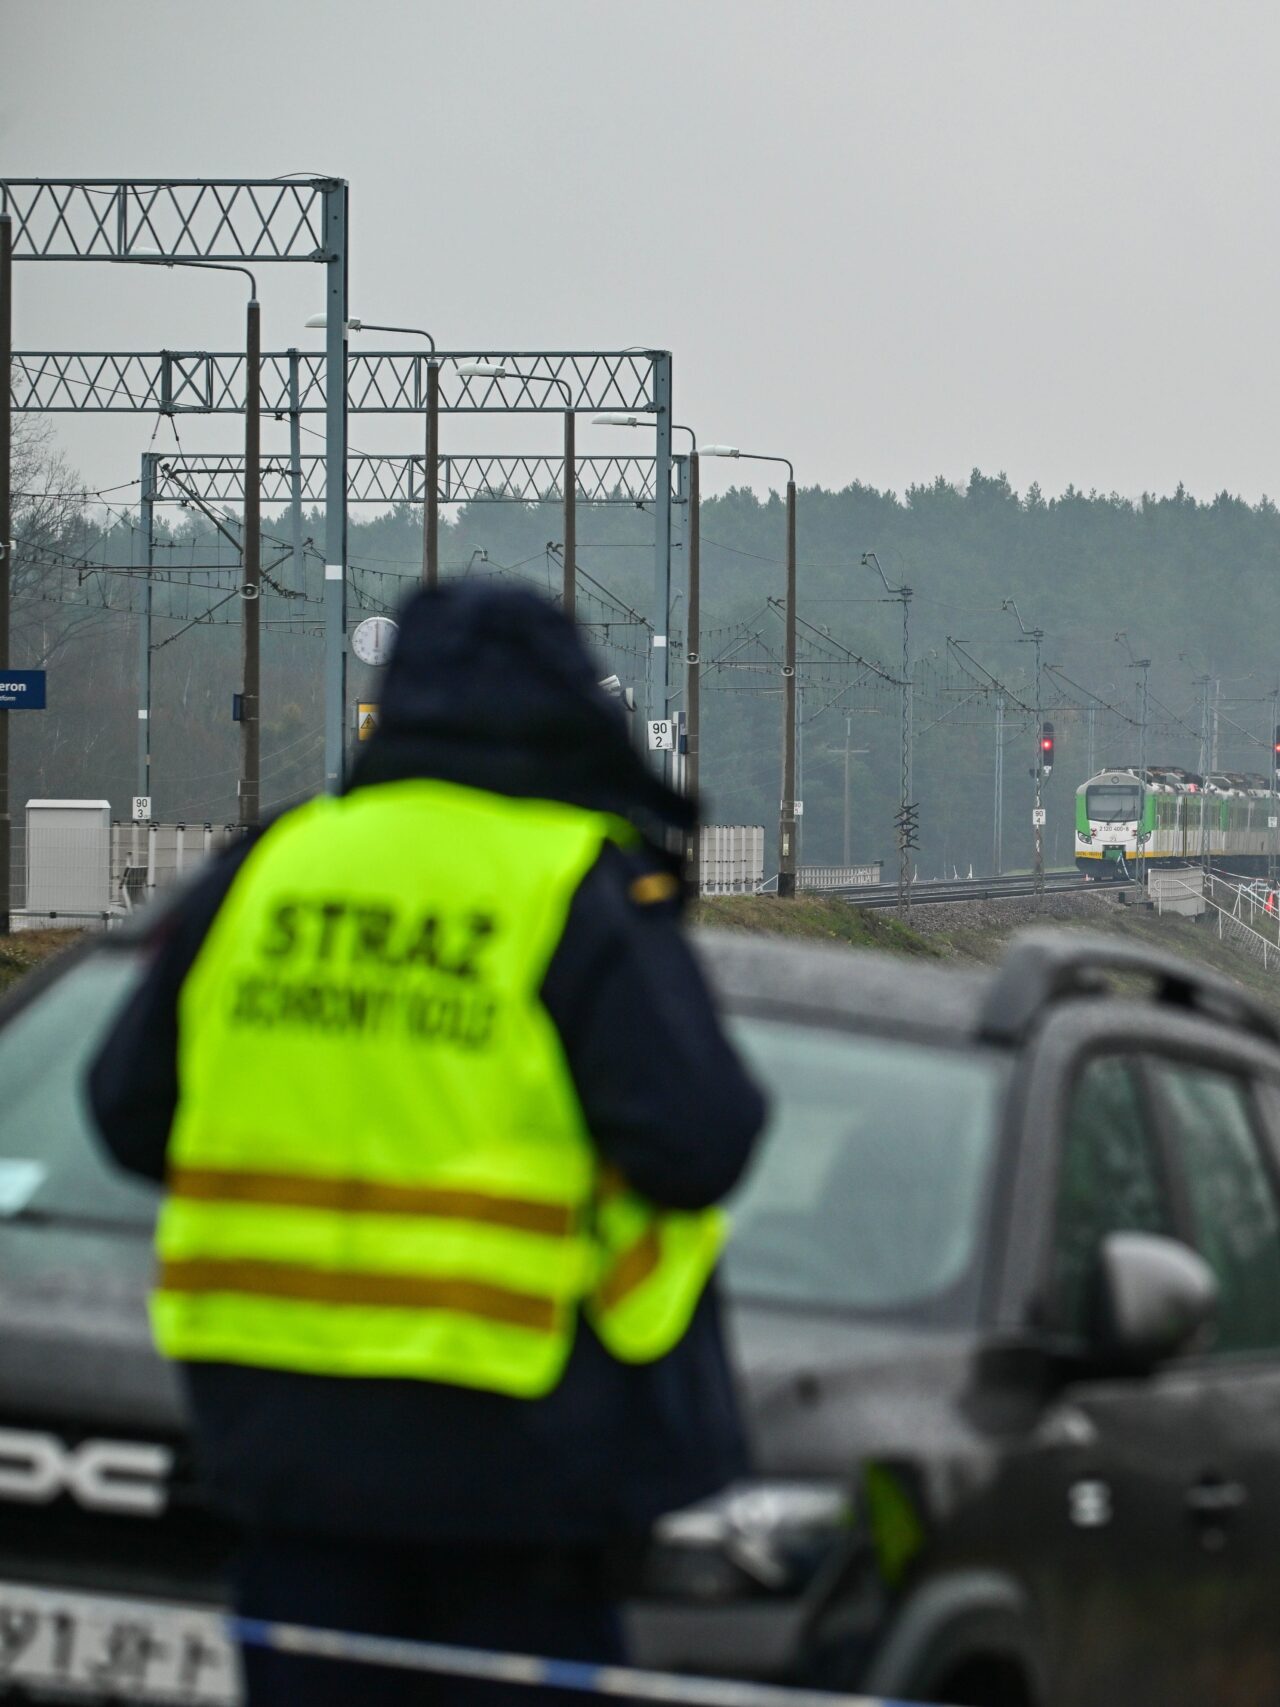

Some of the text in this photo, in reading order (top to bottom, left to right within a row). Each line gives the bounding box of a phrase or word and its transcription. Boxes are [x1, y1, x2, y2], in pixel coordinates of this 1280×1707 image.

[652, 722, 667, 734] 90
[655, 736, 663, 748] 2
[136, 798, 148, 808] 90
[137, 809, 144, 818] 3
